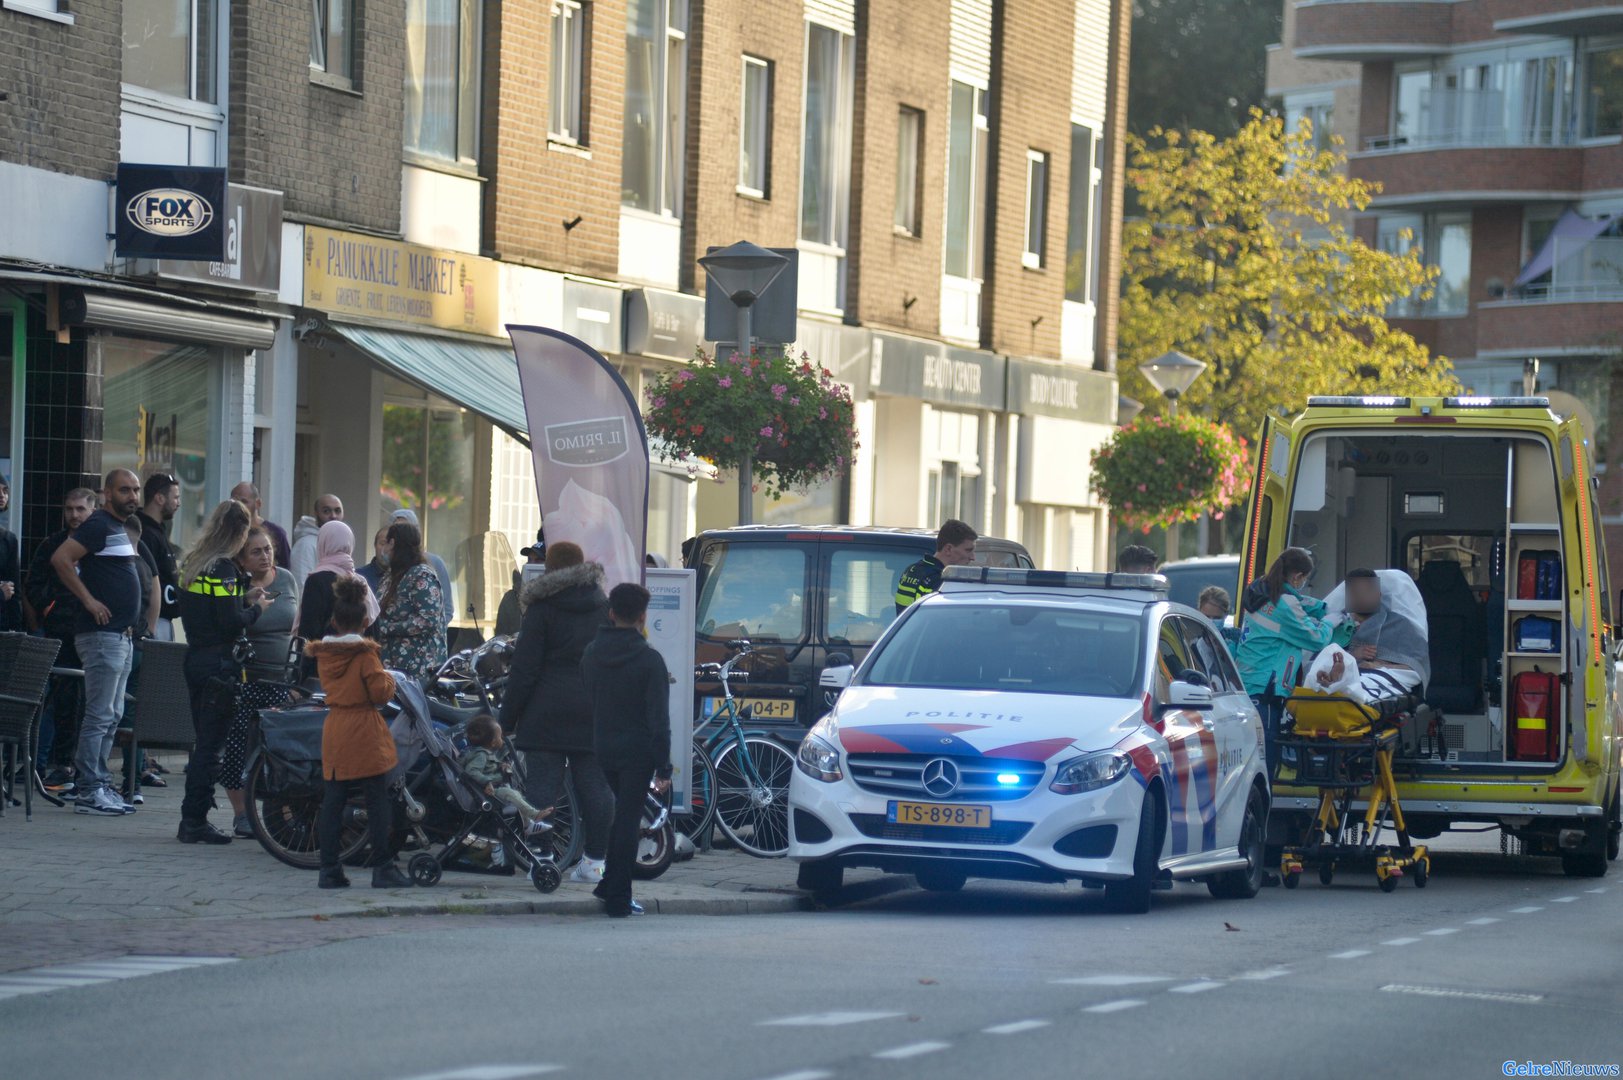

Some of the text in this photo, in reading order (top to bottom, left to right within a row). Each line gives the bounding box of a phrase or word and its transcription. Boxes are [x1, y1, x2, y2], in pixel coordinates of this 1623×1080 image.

[146, 197, 194, 219] FOX
[145, 217, 195, 227] SPORTS
[327, 237, 399, 286] PAMUKKALE
[407, 253, 455, 296] MARKET
[923, 355, 952, 389] BEAUTY
[953, 360, 982, 395] CENTER
[654, 619, 662, 631] €
[906, 711, 1023, 723] POLITIE
[903, 805, 983, 824] TS-898-T
